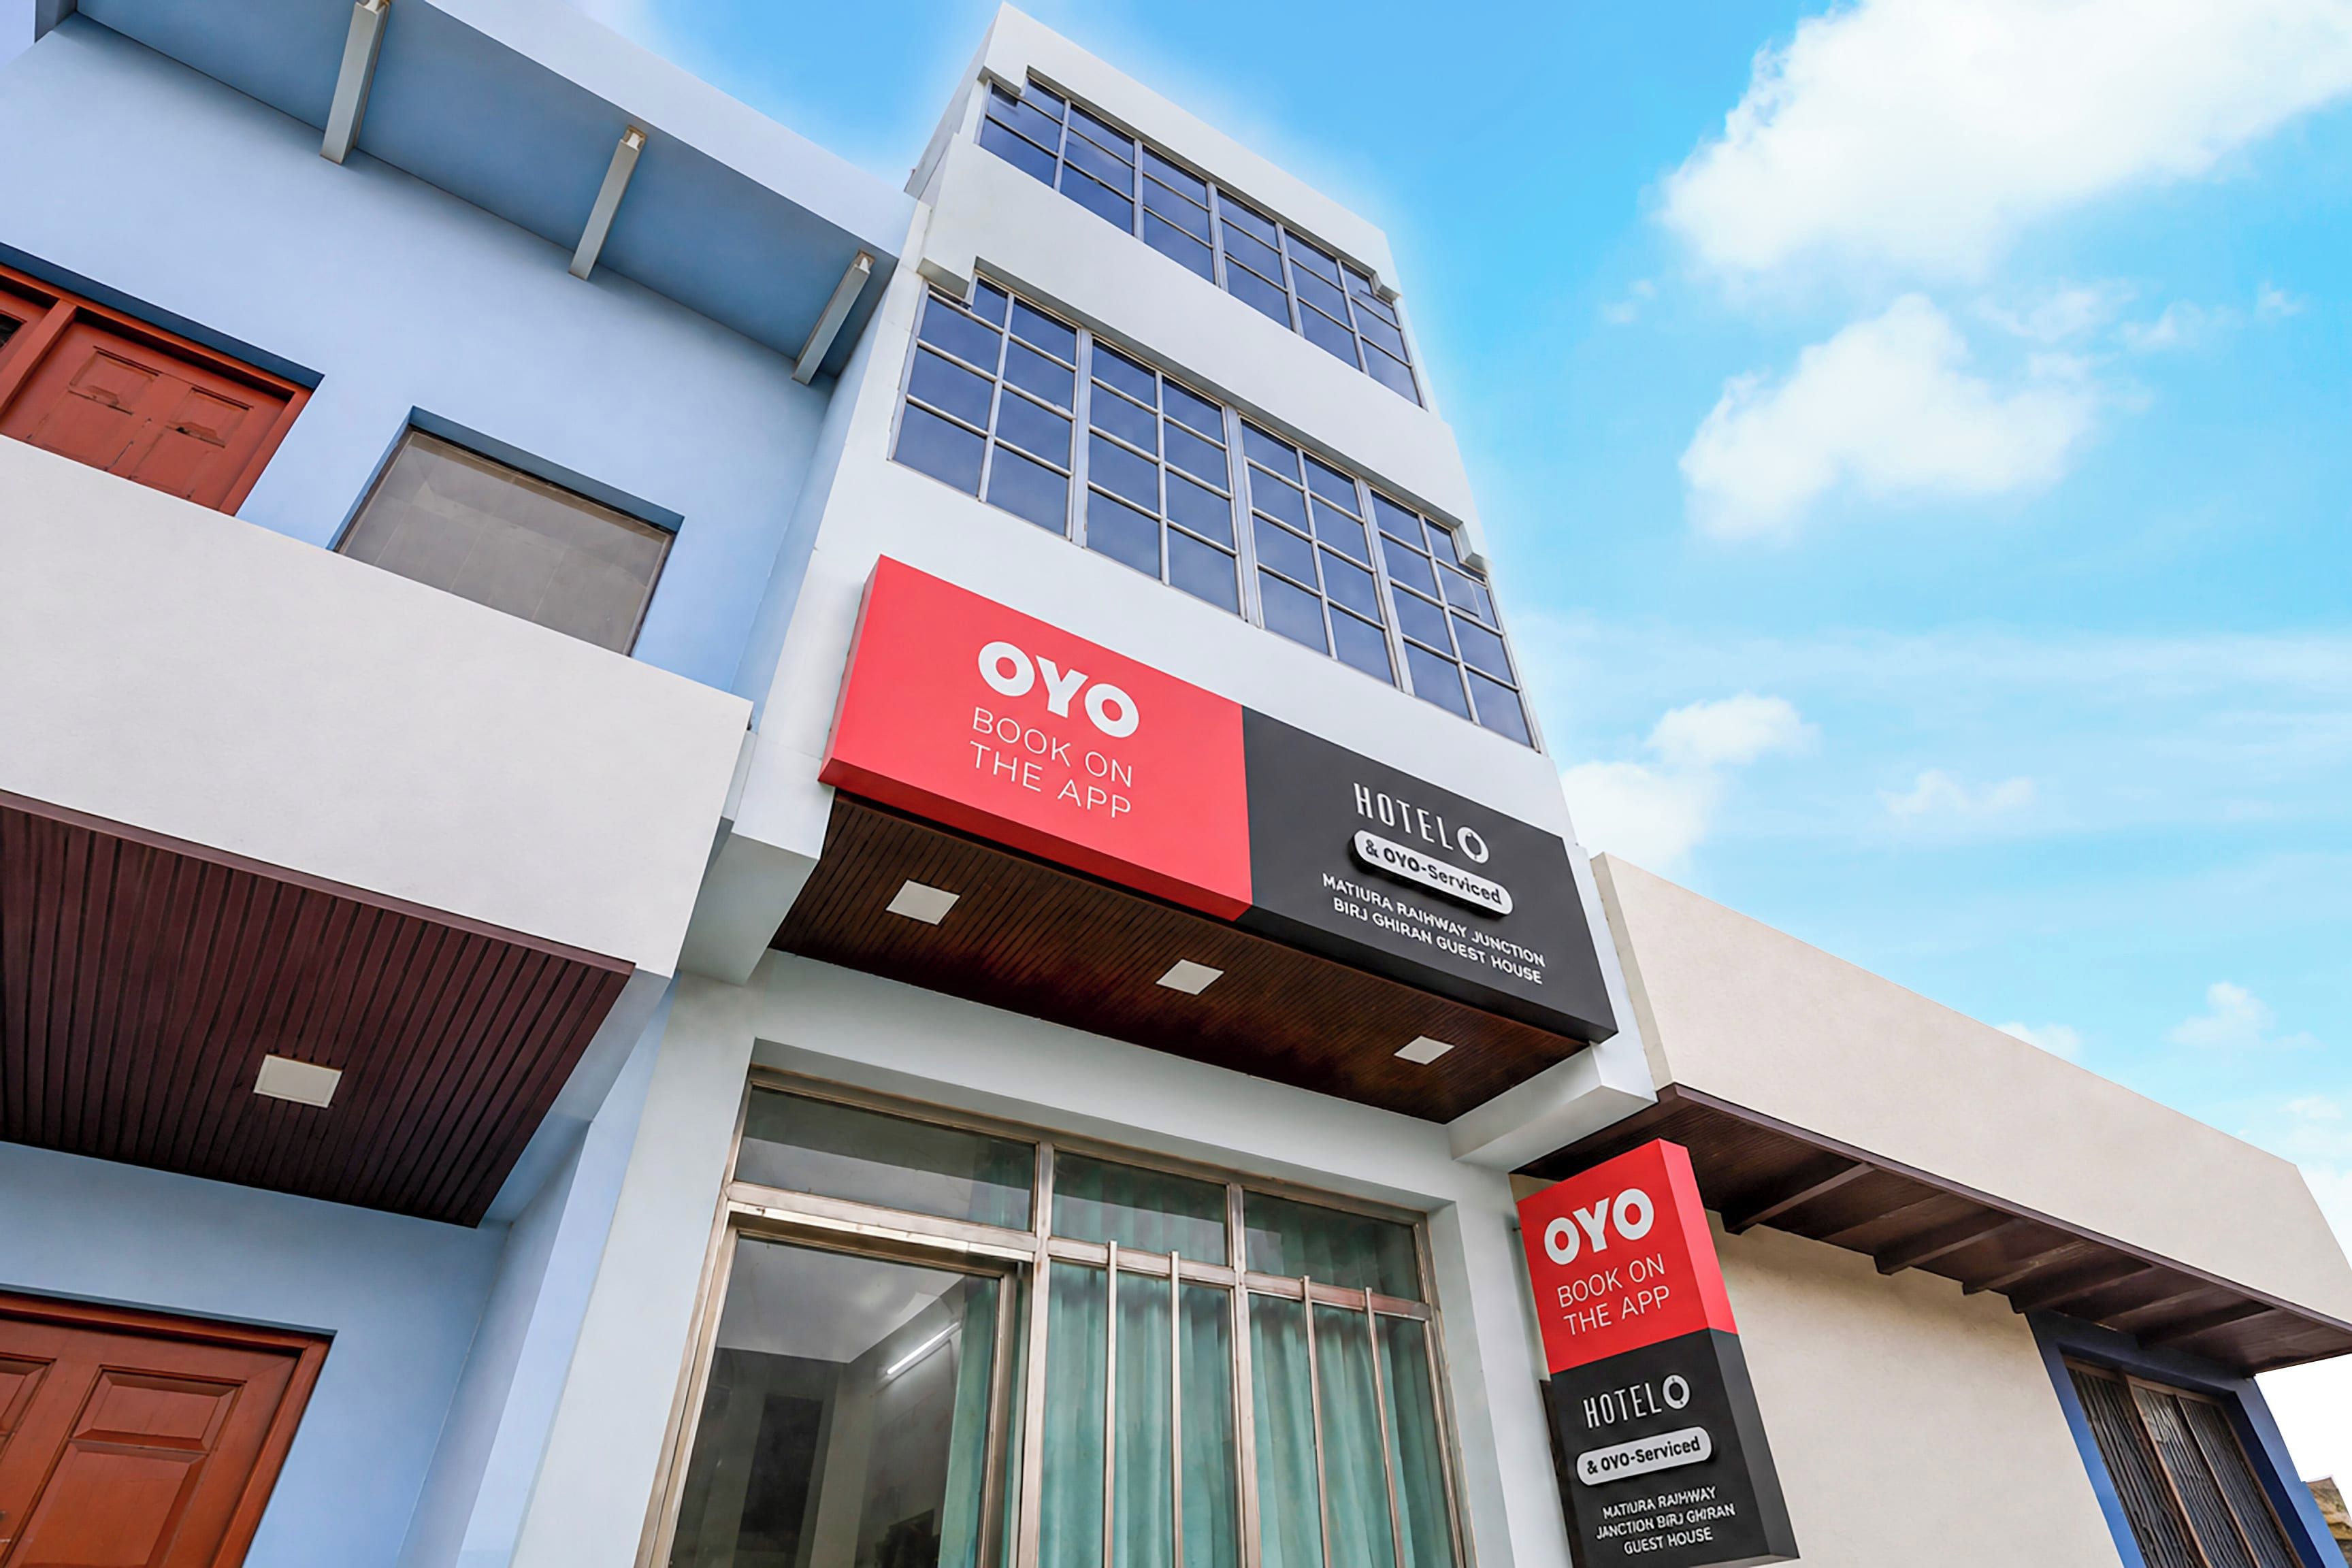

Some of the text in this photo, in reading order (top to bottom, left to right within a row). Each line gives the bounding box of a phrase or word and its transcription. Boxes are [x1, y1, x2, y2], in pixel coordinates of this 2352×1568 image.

[978, 640, 1140, 738] OYO
[970, 740, 1131, 818] THE APP
[973, 706, 1132, 788] BOOK ON
[1365, 838, 1503, 906] & OYO-Serviced
[1333, 897, 1544, 985] BIRJ GHIRAN GUEST HOUSE
[1471, 930, 1546, 968] JUNCTION
[1544, 1188, 1654, 1265] OYO
[1557, 1253, 1665, 1308] BOOK ON
[1563, 1286, 1669, 1335] THE APP
[1587, 1436, 1701, 1474] & OYO-Serviced
[1624, 1526, 1713, 1555] GUEST HOUSE
